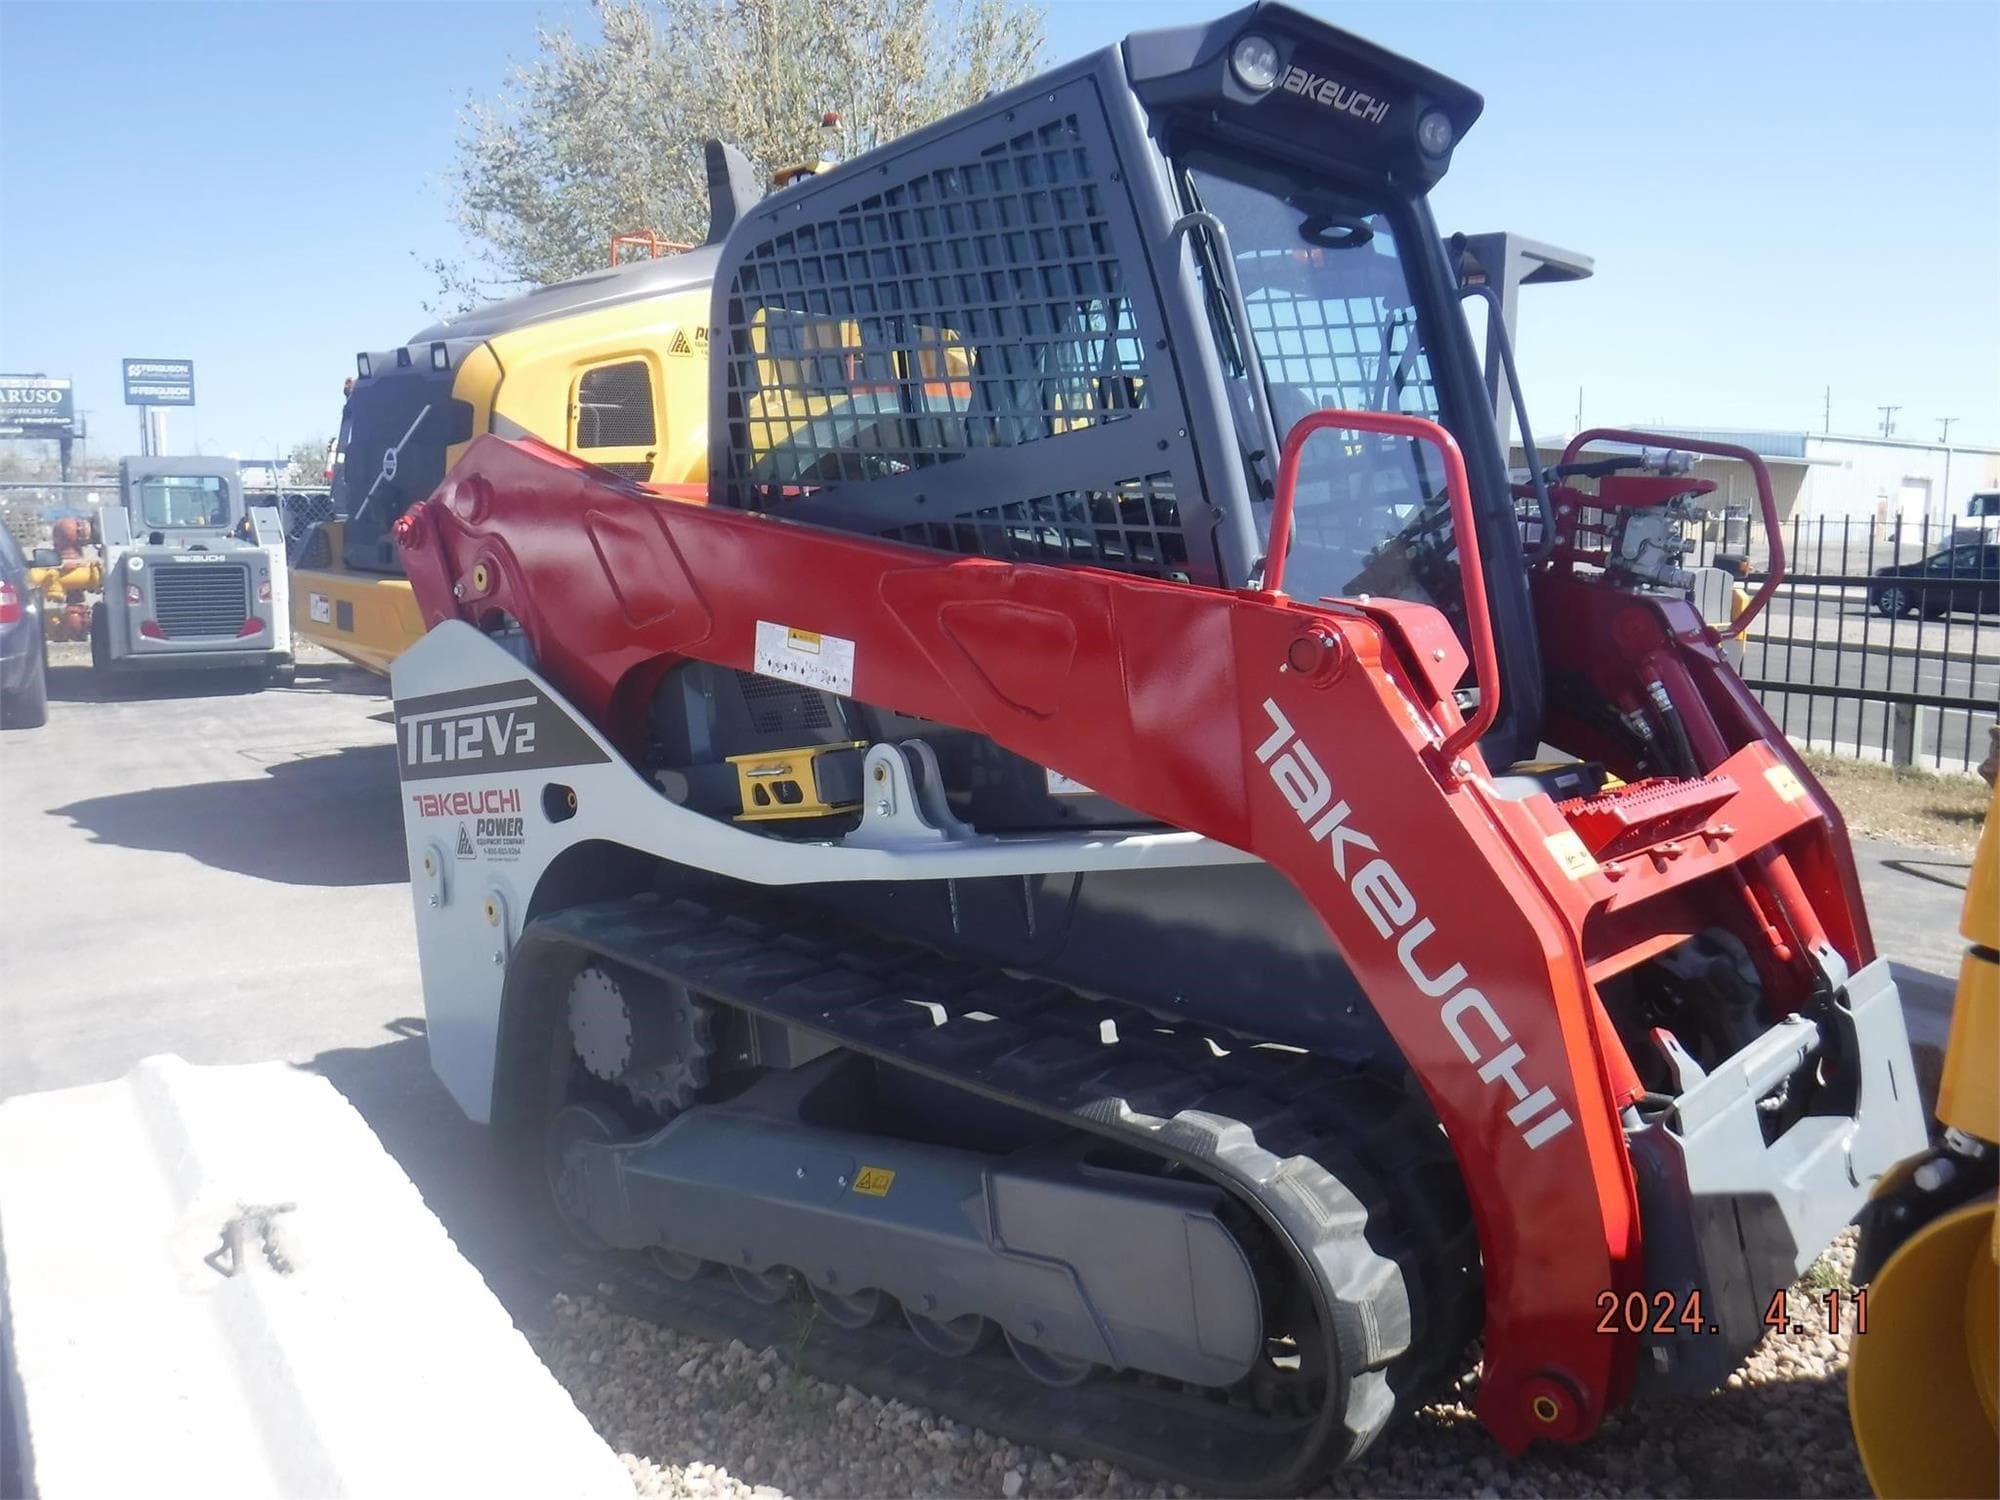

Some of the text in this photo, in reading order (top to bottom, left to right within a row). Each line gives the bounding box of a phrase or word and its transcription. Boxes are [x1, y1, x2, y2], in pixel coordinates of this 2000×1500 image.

[412, 788, 521, 817] TAKEUCHI
[476, 817, 524, 837] POWER
[502, 837, 525, 846] COMPANY
[1254, 697, 1573, 1150] TAKEUCHI
